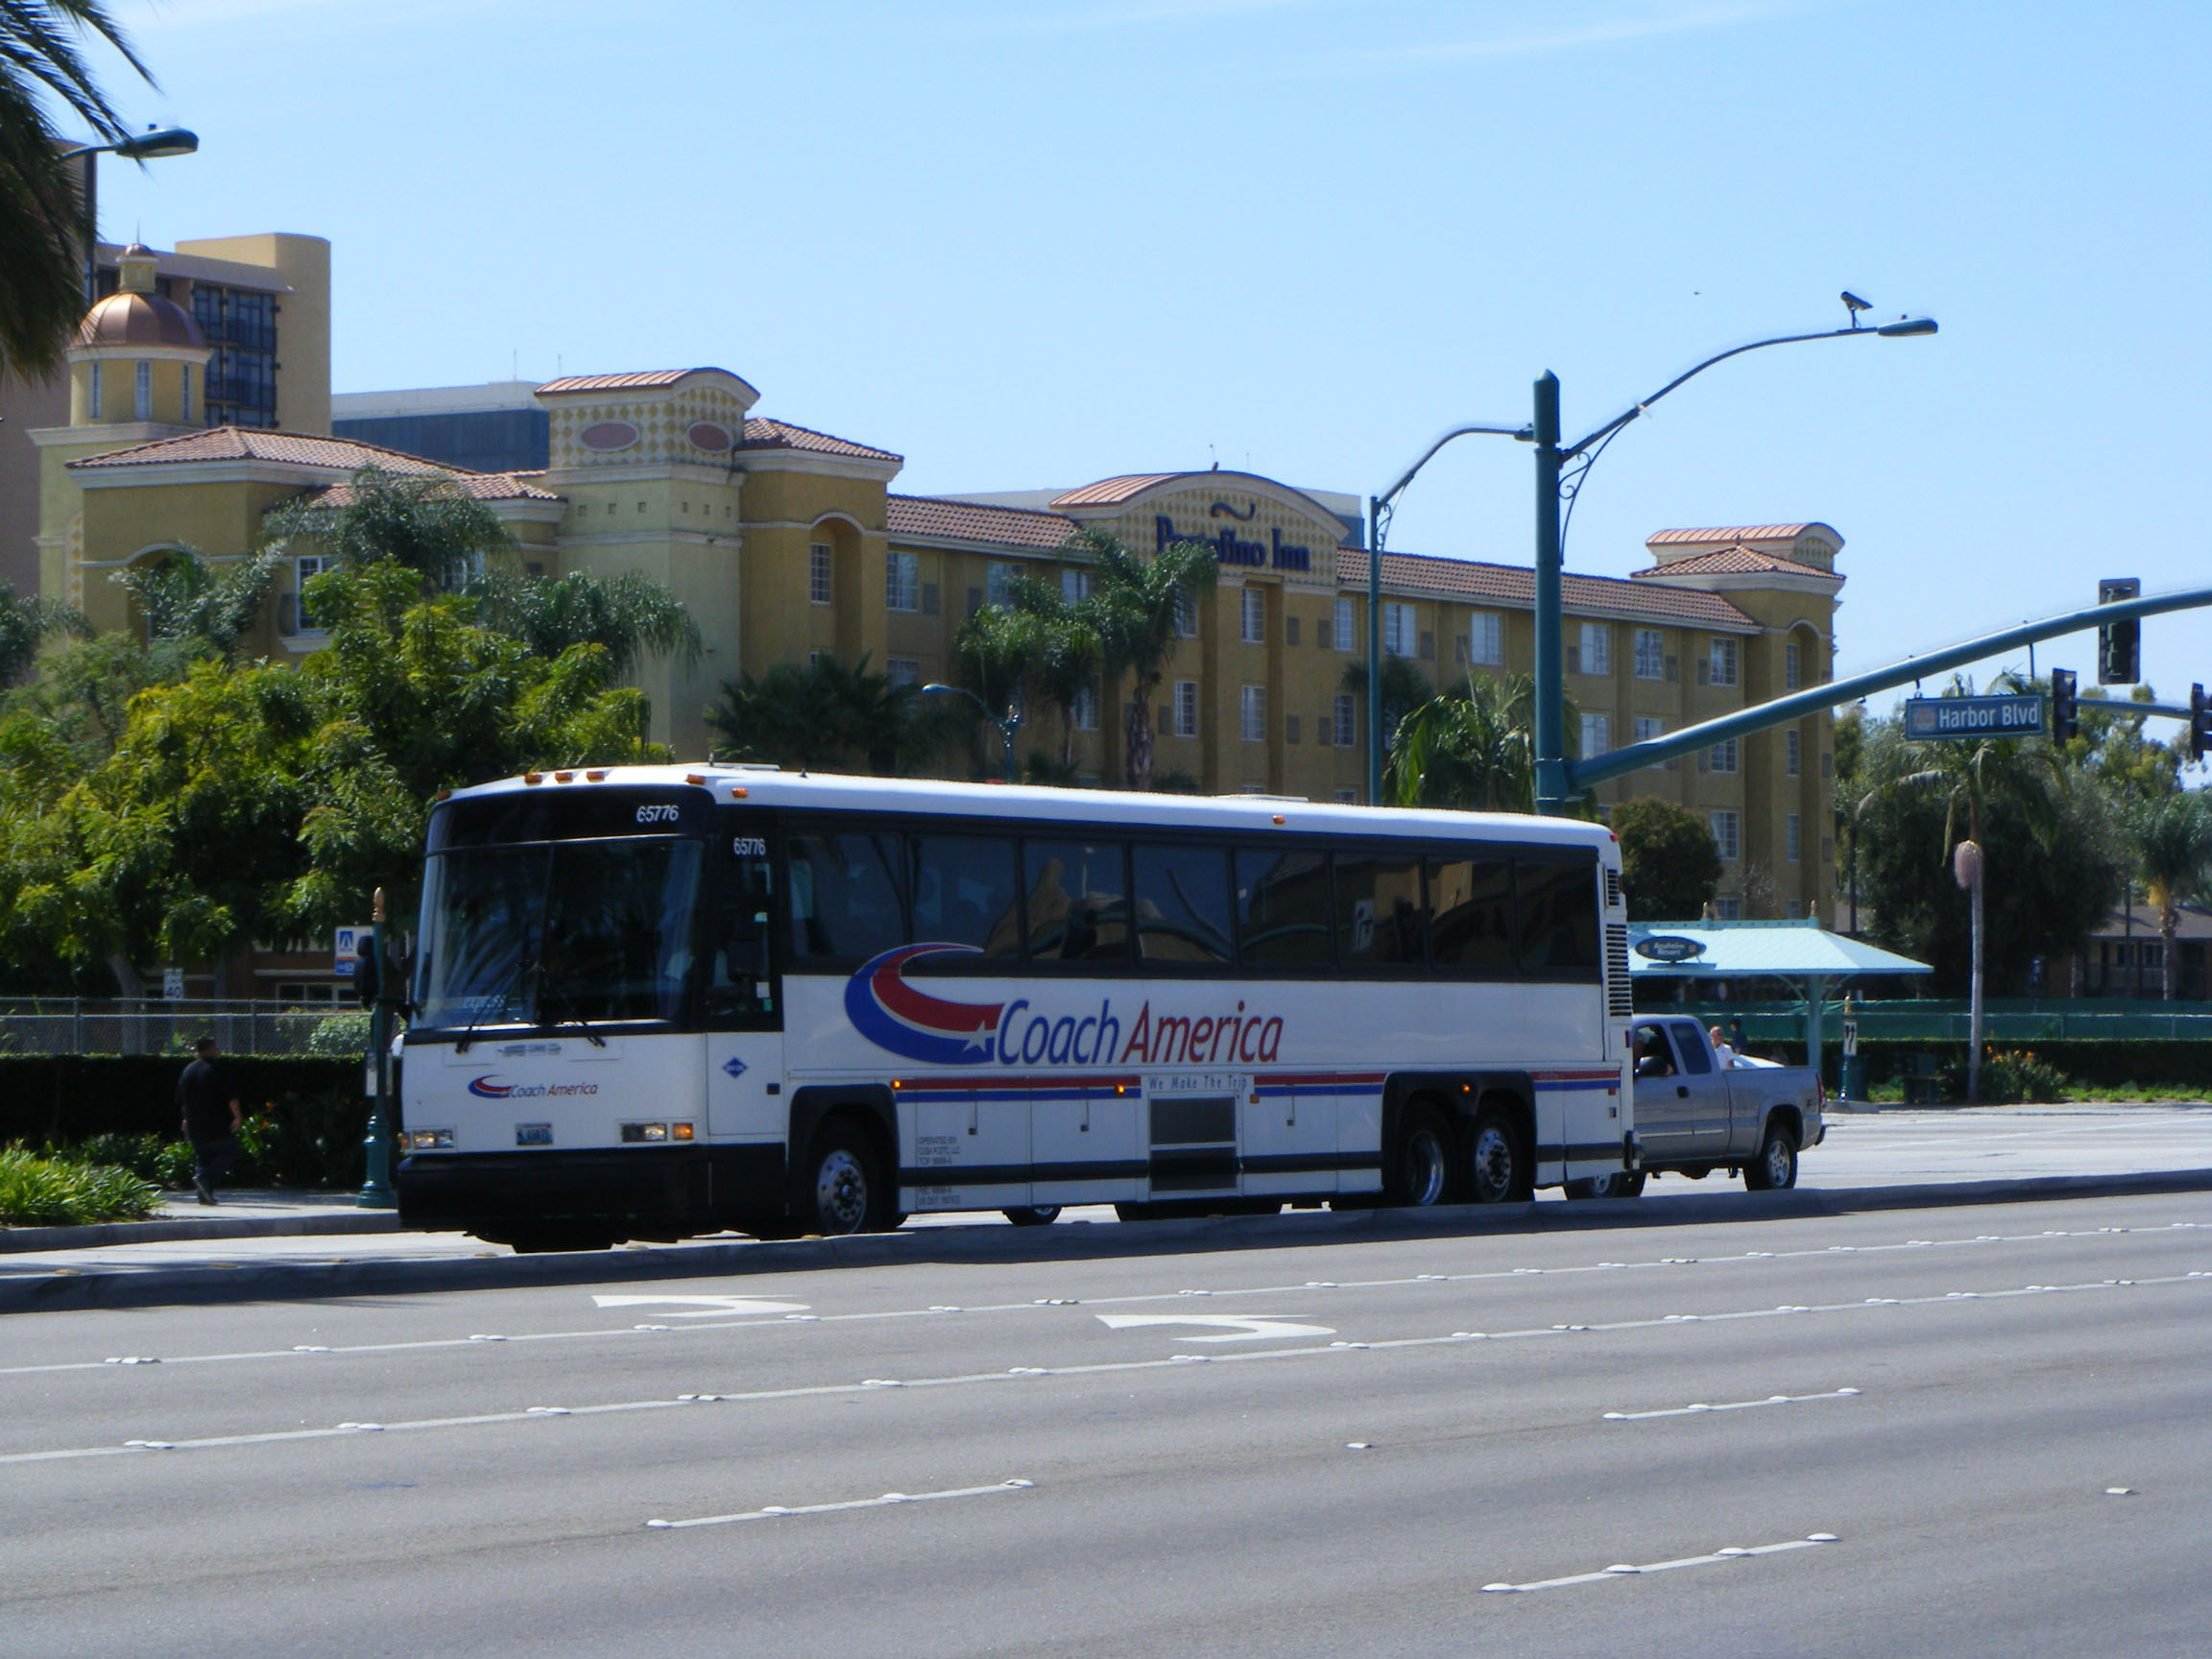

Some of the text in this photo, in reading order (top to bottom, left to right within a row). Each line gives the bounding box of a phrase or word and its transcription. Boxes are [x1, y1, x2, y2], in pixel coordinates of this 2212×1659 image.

[1271, 528, 1310, 571] Inn
[1939, 702, 2038, 729] Harbor Blvd
[636, 805, 679, 823] 65776
[733, 837, 766, 855] 65776
[998, 998, 1284, 1065] Coach America
[510, 1082, 598, 1098] Coach America
[1149, 1074, 1248, 1091] We Make The Trip
